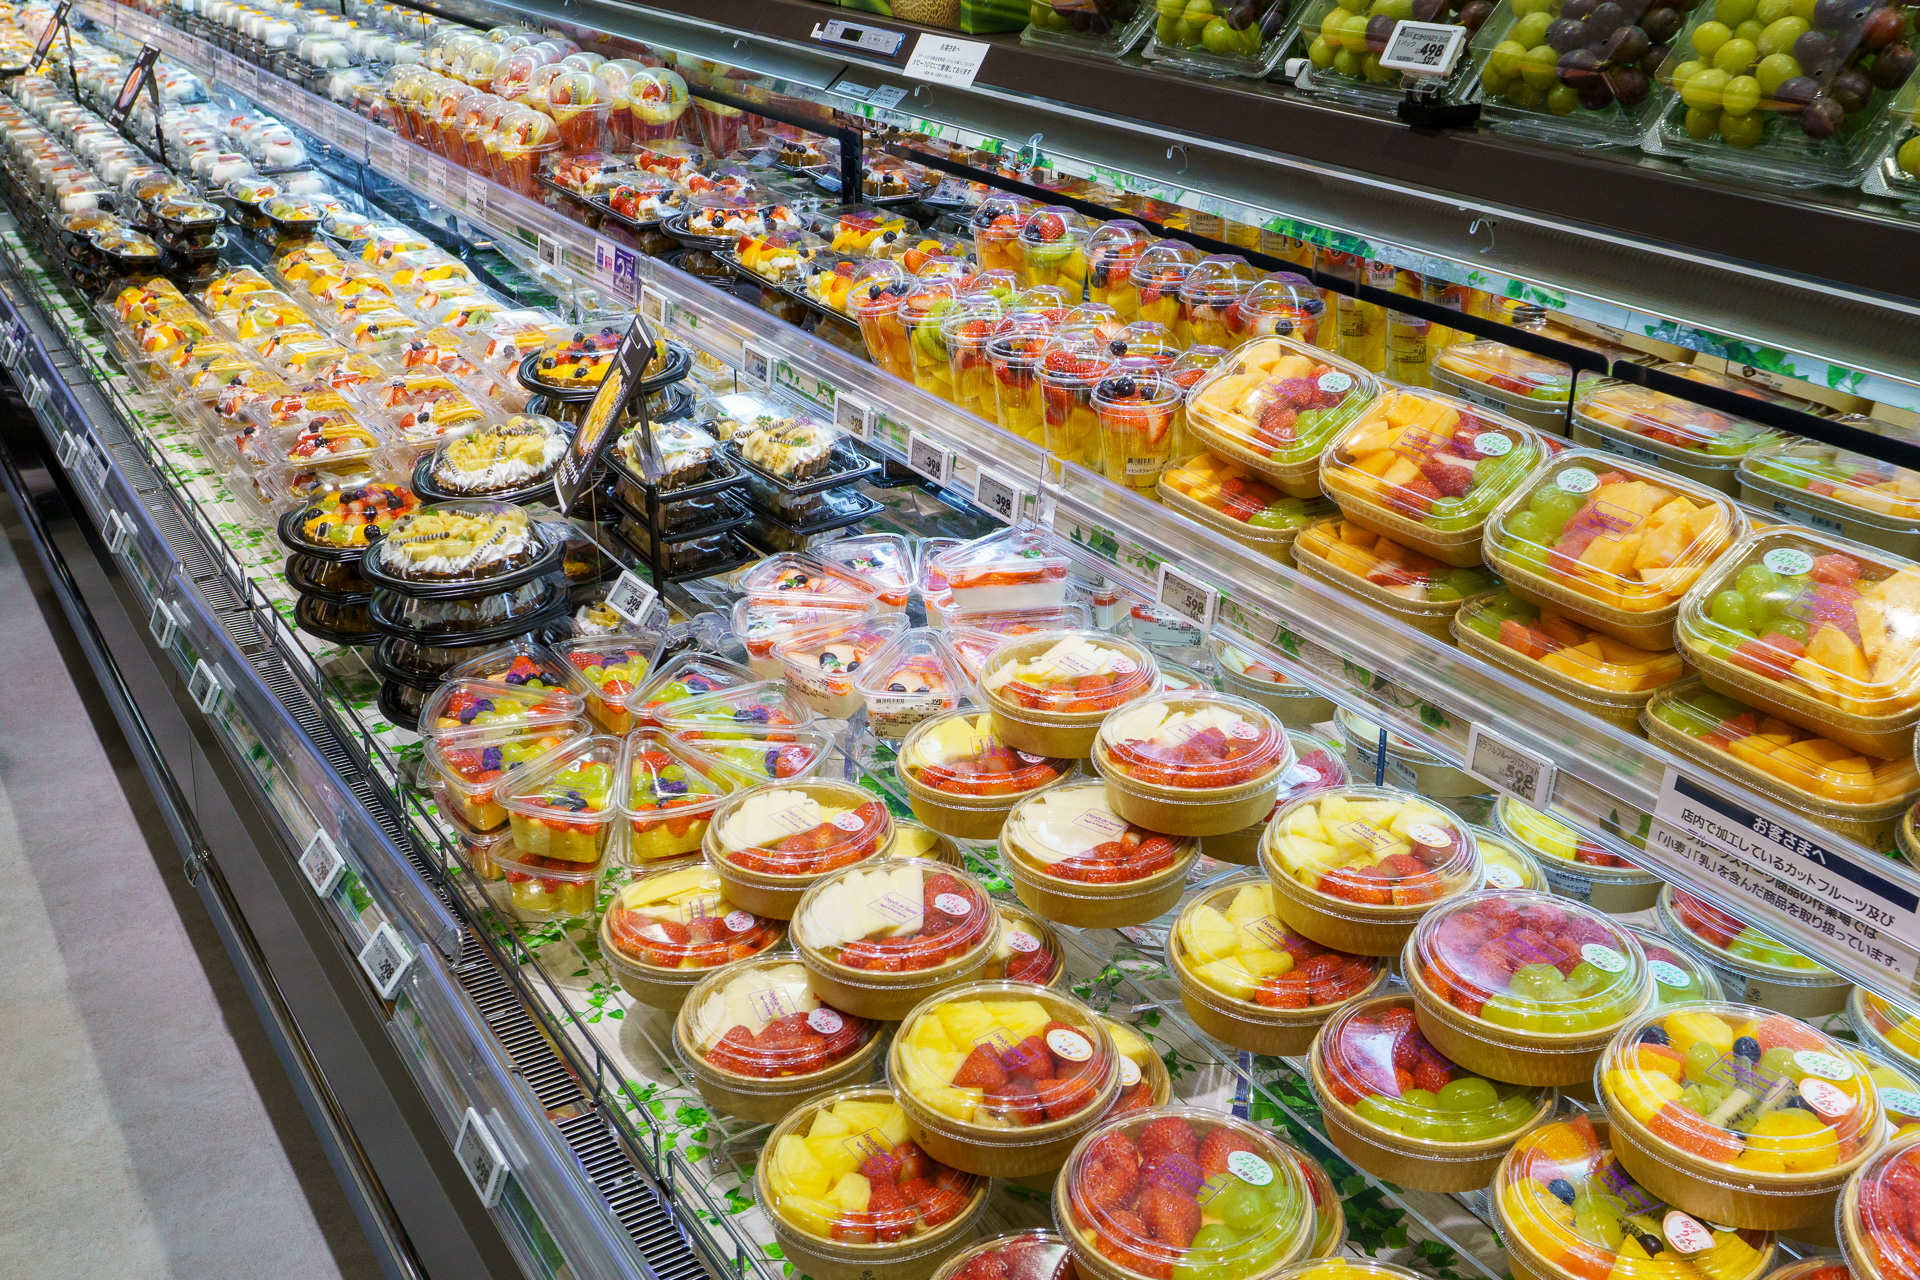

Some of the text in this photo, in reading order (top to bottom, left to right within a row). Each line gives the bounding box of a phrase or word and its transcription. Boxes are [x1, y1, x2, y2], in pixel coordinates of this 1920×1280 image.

[1420, 43, 1444, 56] 498
[926, 456, 940, 472] 398
[996, 494, 1011, 511] 398
[627, 596, 641, 610] 398
[1186, 595, 1204, 614] 598
[1505, 764, 1534, 790] 598
[1752, 816, 1828, 866] お客さまへ
[316, 861, 329, 880] 298
[1681, 808, 1896, 928] 店内で加工しているカットフルーツ及び
[1656, 830, 1902, 973] 「小麦」「乳」を含んだ商品を取り扱っています。
[380, 959, 395, 980] 298
[1056, 1033, 1082, 1054] バナナ
[1802, 1056, 1846, 1076] マスカット
[1809, 1051, 1846, 1068] シャイン
[1236, 1158, 1264, 1181] マスカット
[1245, 1154, 1270, 1175] シャイン
[1681, 1221, 1700, 1234] 国産
